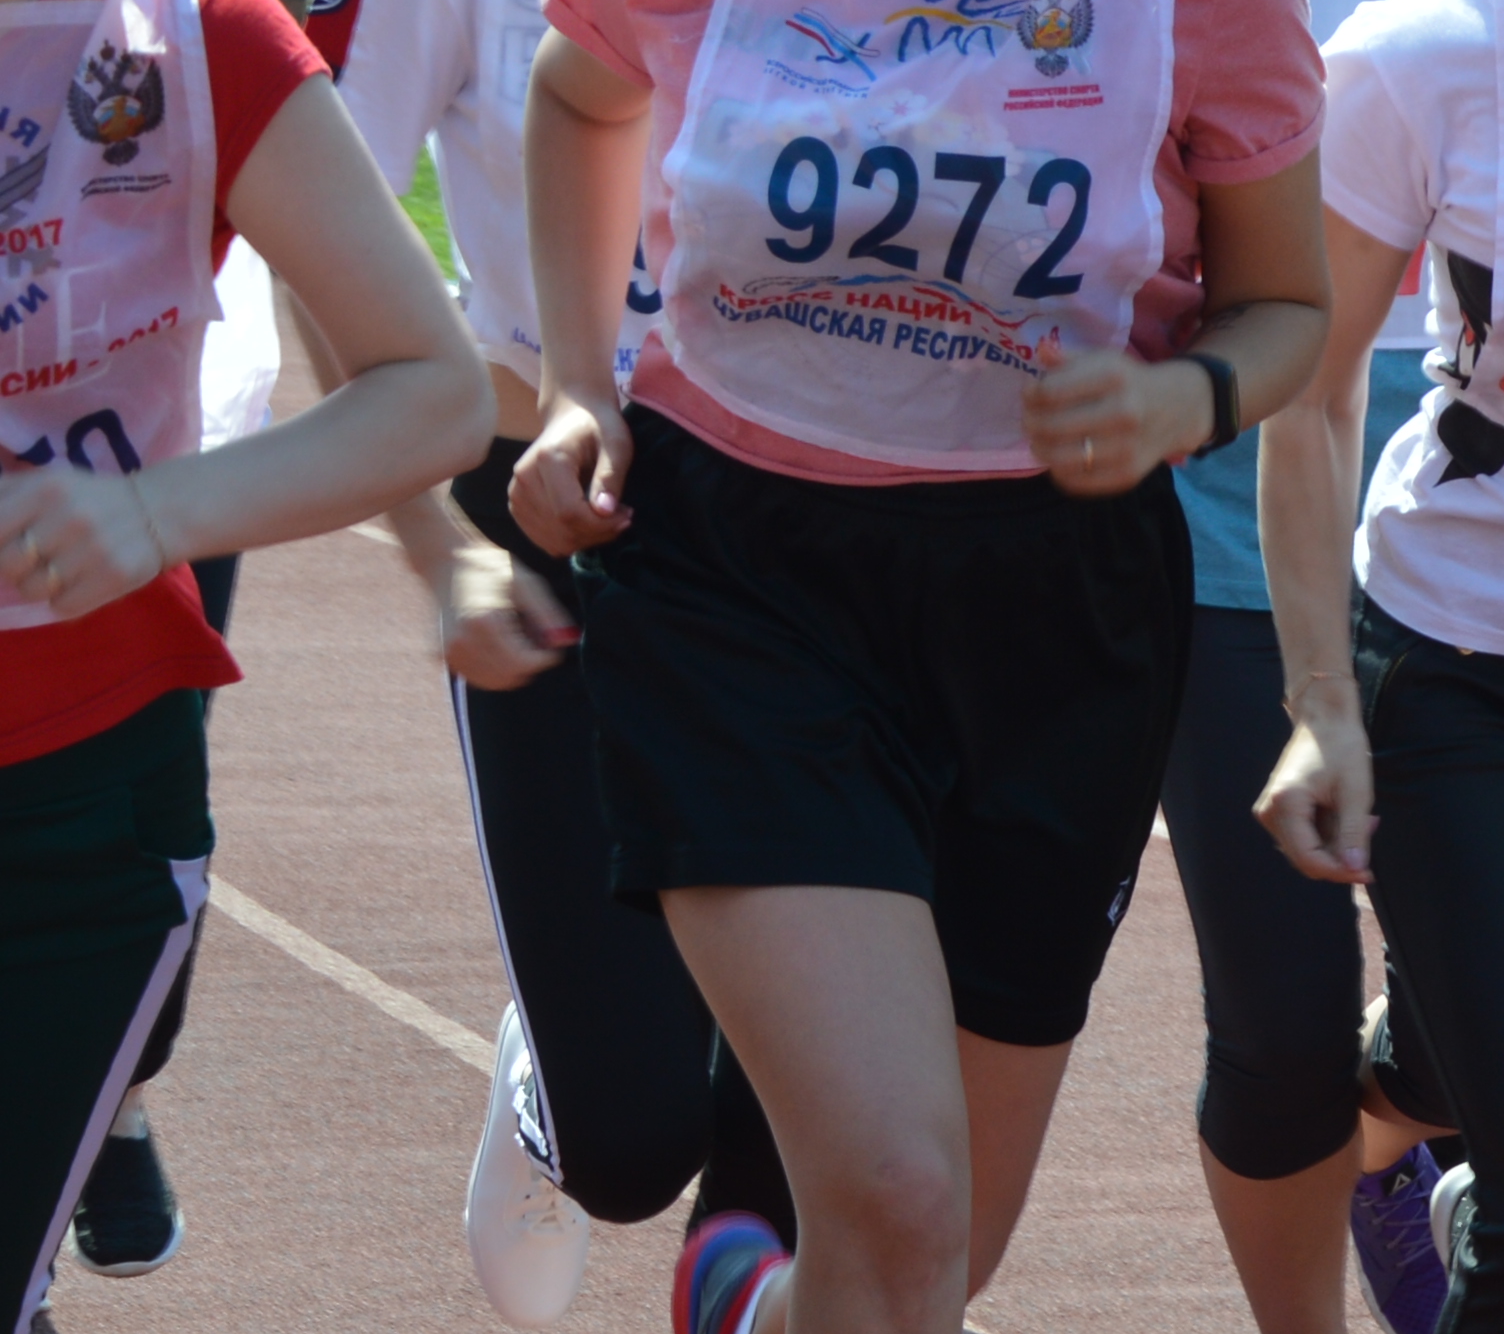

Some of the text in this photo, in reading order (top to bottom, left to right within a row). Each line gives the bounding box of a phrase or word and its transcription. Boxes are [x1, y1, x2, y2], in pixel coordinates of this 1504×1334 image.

[765, 136, 1092, 299] 9272
[712, 294, 888, 345] ЧУВАШСКАЯ
[719, 283, 834, 310] КРОСС
[846, 291, 973, 326] НАЦИИ
